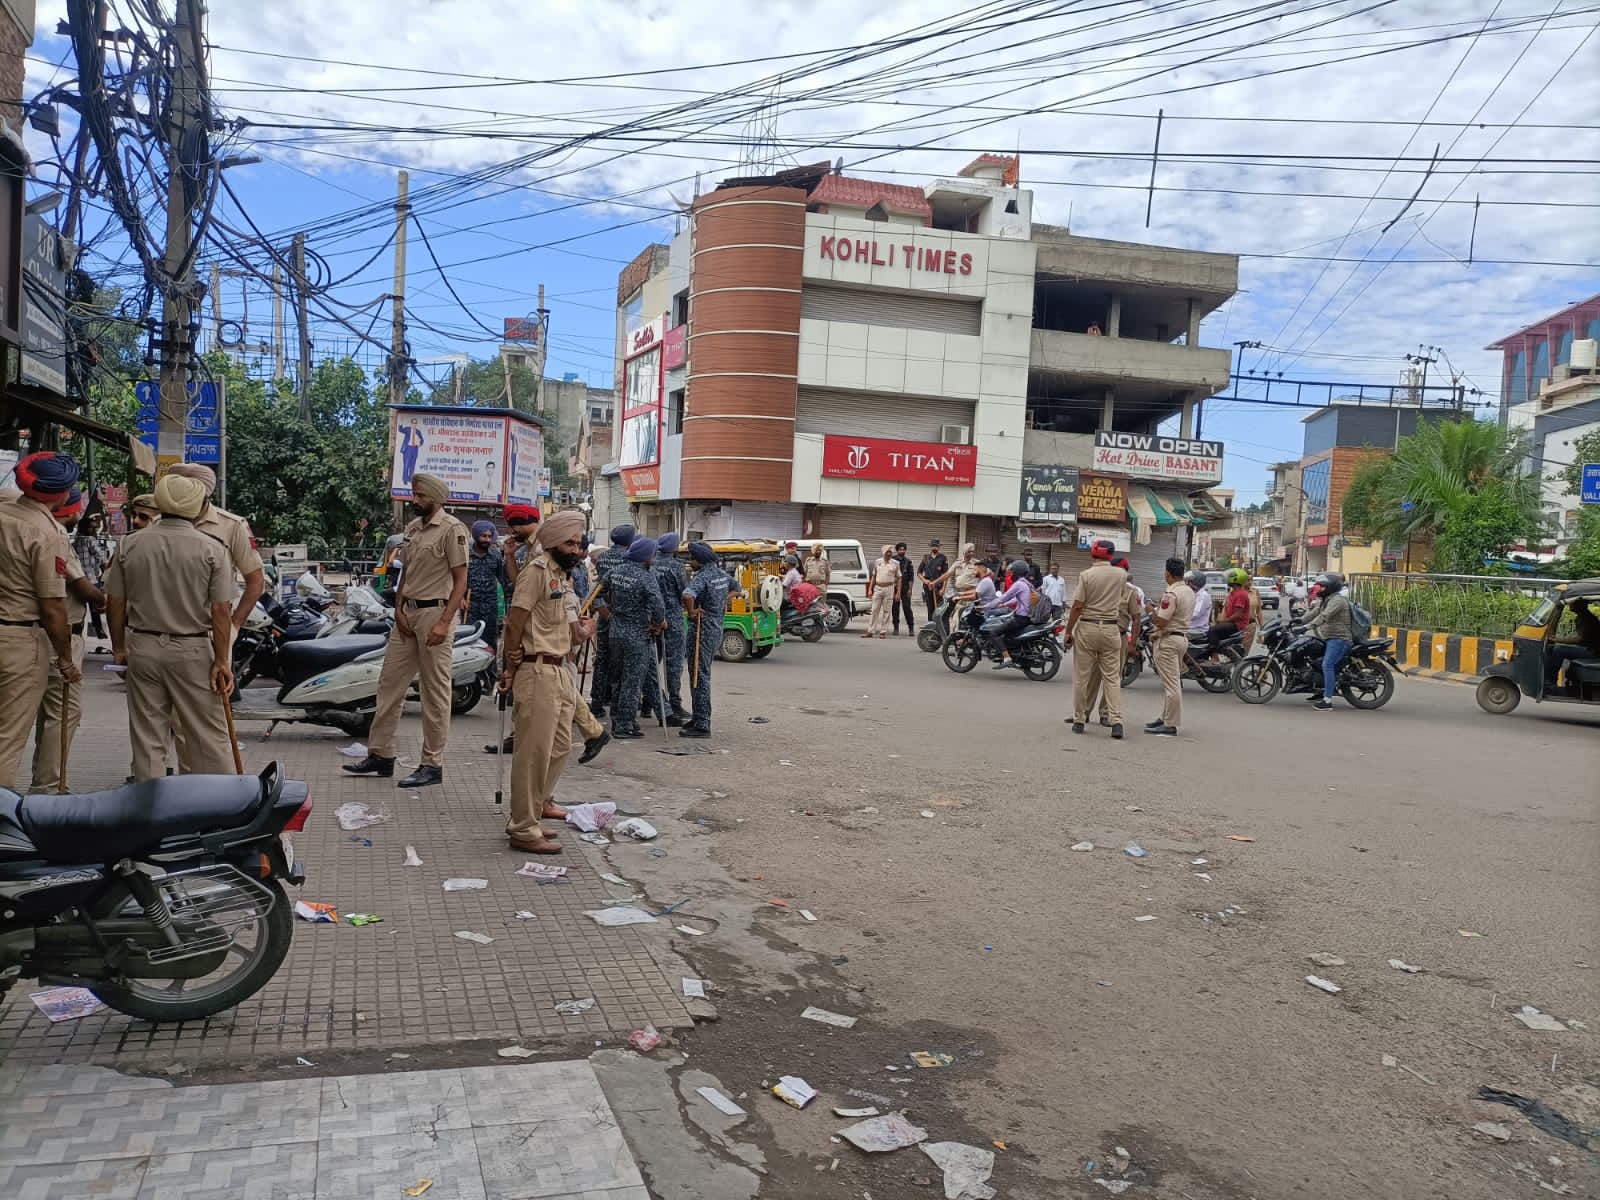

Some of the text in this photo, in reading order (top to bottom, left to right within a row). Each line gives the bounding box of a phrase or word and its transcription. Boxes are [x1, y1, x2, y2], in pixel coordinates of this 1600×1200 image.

[820, 235, 973, 276] KOHLI TIMES
[1100, 432, 1218, 456] NOW OPEN
[888, 453, 955, 472] TITAN
[1097, 449, 1160, 468] Hot Drive
[1165, 455, 1218, 472] BASANT
[1082, 484, 1123, 498] VERMA
[1584, 492, 1600, 500] VAL
[1078, 495, 1125, 510] OPTICAL
